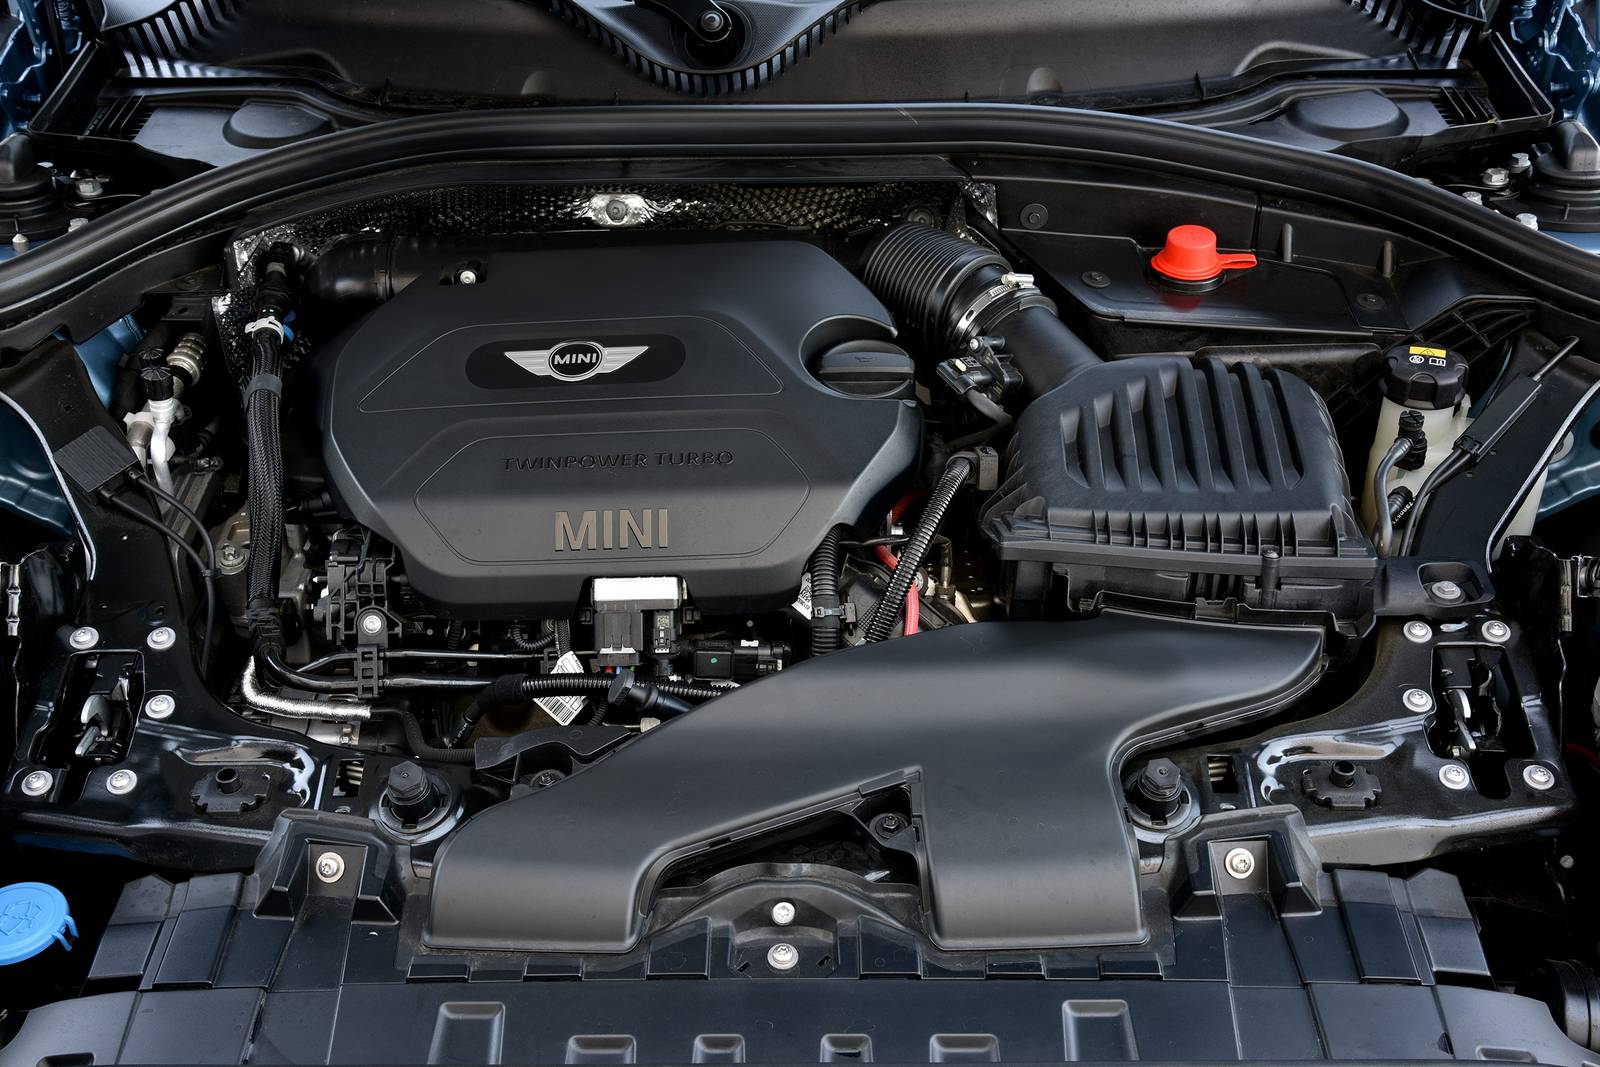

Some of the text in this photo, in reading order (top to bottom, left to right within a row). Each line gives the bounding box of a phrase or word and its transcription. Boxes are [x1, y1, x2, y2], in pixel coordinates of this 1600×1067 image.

[554, 353, 597, 364] MINI
[503, 450, 736, 471] TWINPOWER TURBO
[554, 508, 669, 551] MINI
